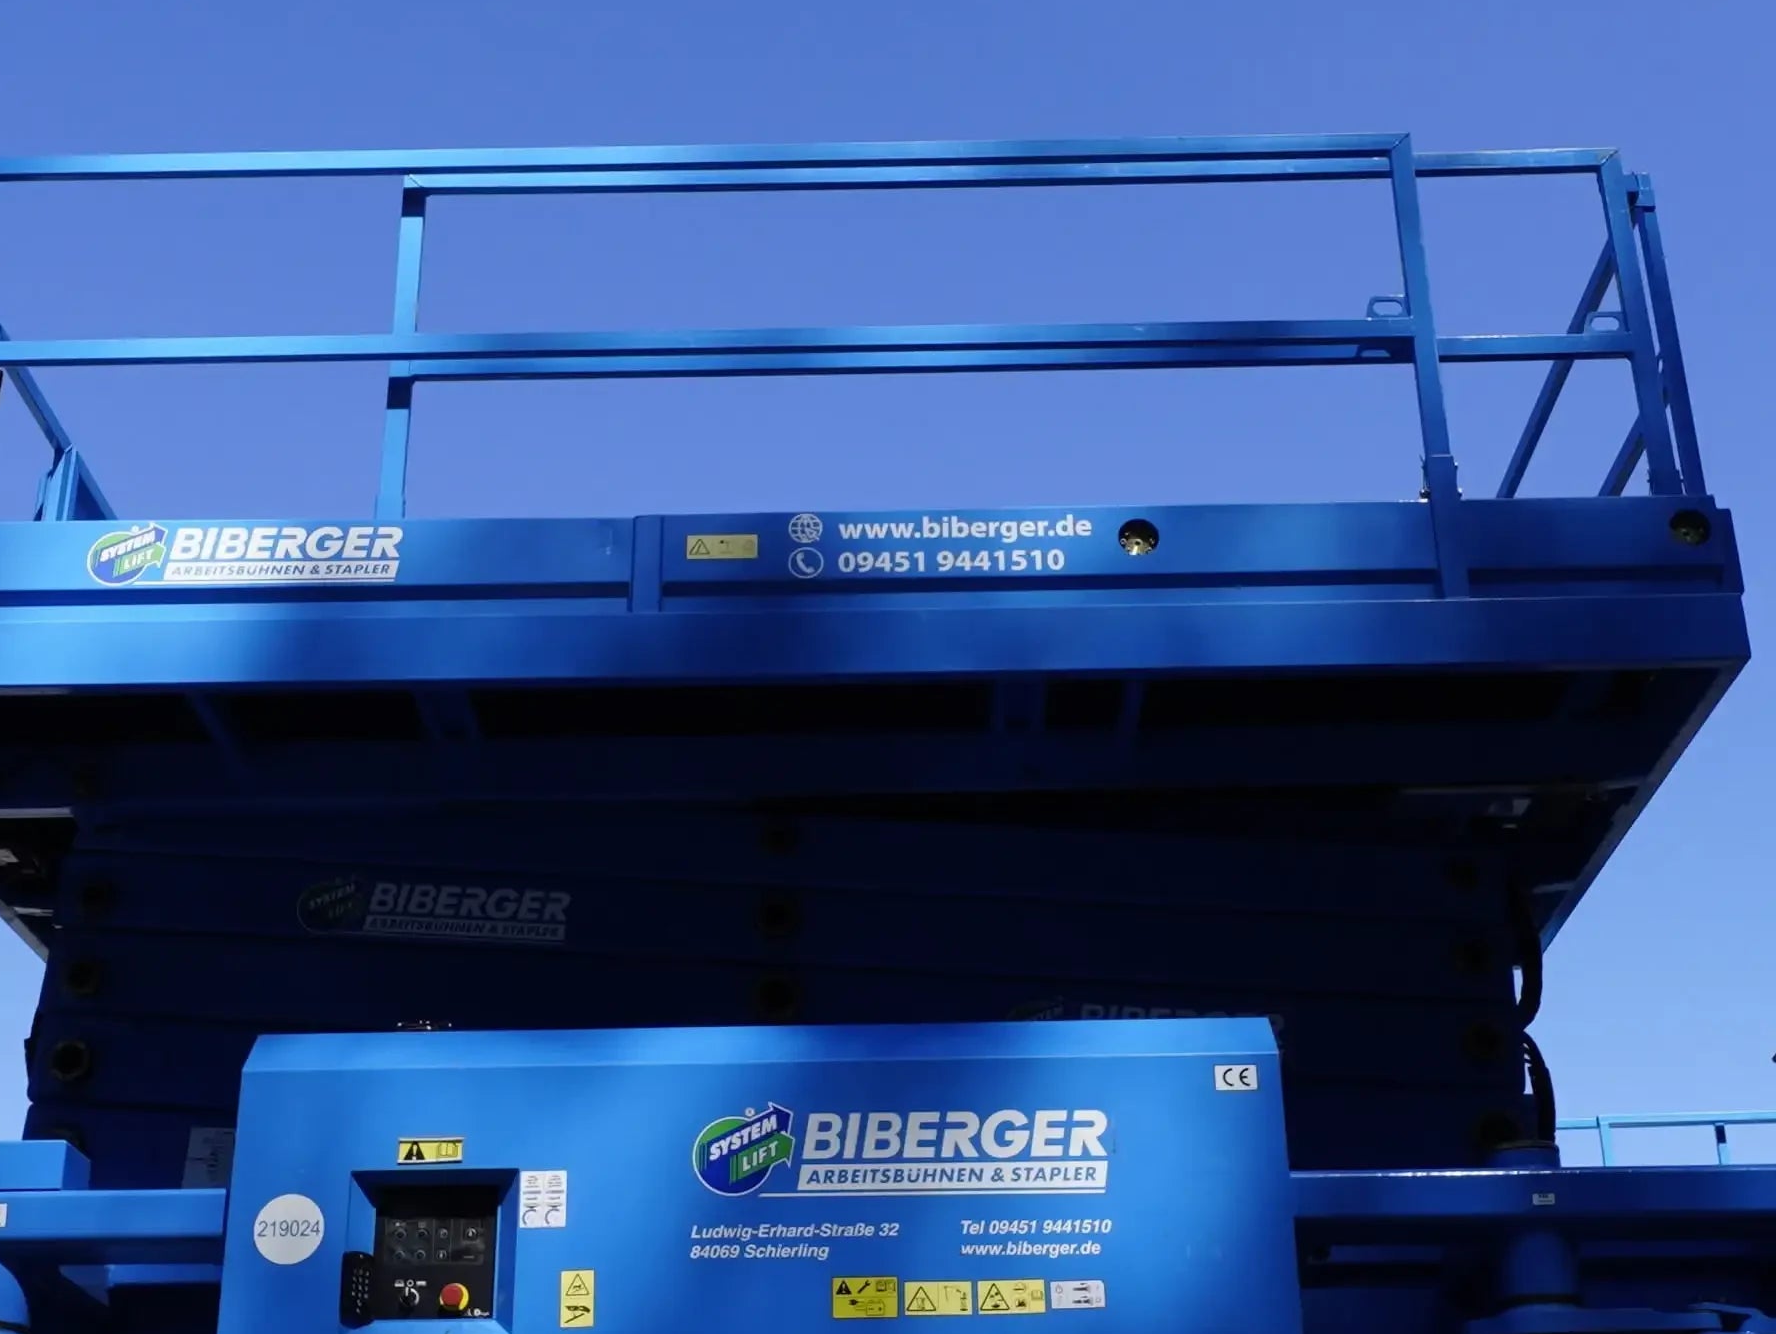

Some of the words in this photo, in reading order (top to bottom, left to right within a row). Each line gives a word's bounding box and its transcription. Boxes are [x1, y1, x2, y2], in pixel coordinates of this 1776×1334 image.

[838, 515, 1092, 543] www.biberger.de
[170, 526, 402, 560] BIBERGER
[310, 564, 320, 575] &
[325, 563, 390, 575] STAPLER
[838, 551, 925, 573] 09451
[938, 549, 1065, 571] 9441510
[368, 881, 571, 921] BIBERGER
[1223, 1068, 1251, 1087] CE
[709, 1114, 777, 1161] SYSTEM
[802, 1109, 1107, 1160] BIBERGER
[742, 1141, 778, 1171] LIFT
[806, 1167, 984, 1185] ARBEITSBÜHNEN
[991, 1167, 1004, 1182] &
[1011, 1166, 1097, 1182] STAPLER
[257, 1219, 320, 1237] 219024
[690, 1223, 875, 1241] Ludwig-Erhard-Straße
[879, 1223, 900, 1236] 32
[960, 1220, 985, 1235] Tel
[989, 1220, 1036, 1235] 09451
[1043, 1219, 1112, 1234] 9441510
[690, 1244, 740, 1259] 84069
[744, 1243, 829, 1261] Schierling
[961, 1240, 1101, 1259] www.biberger.de
